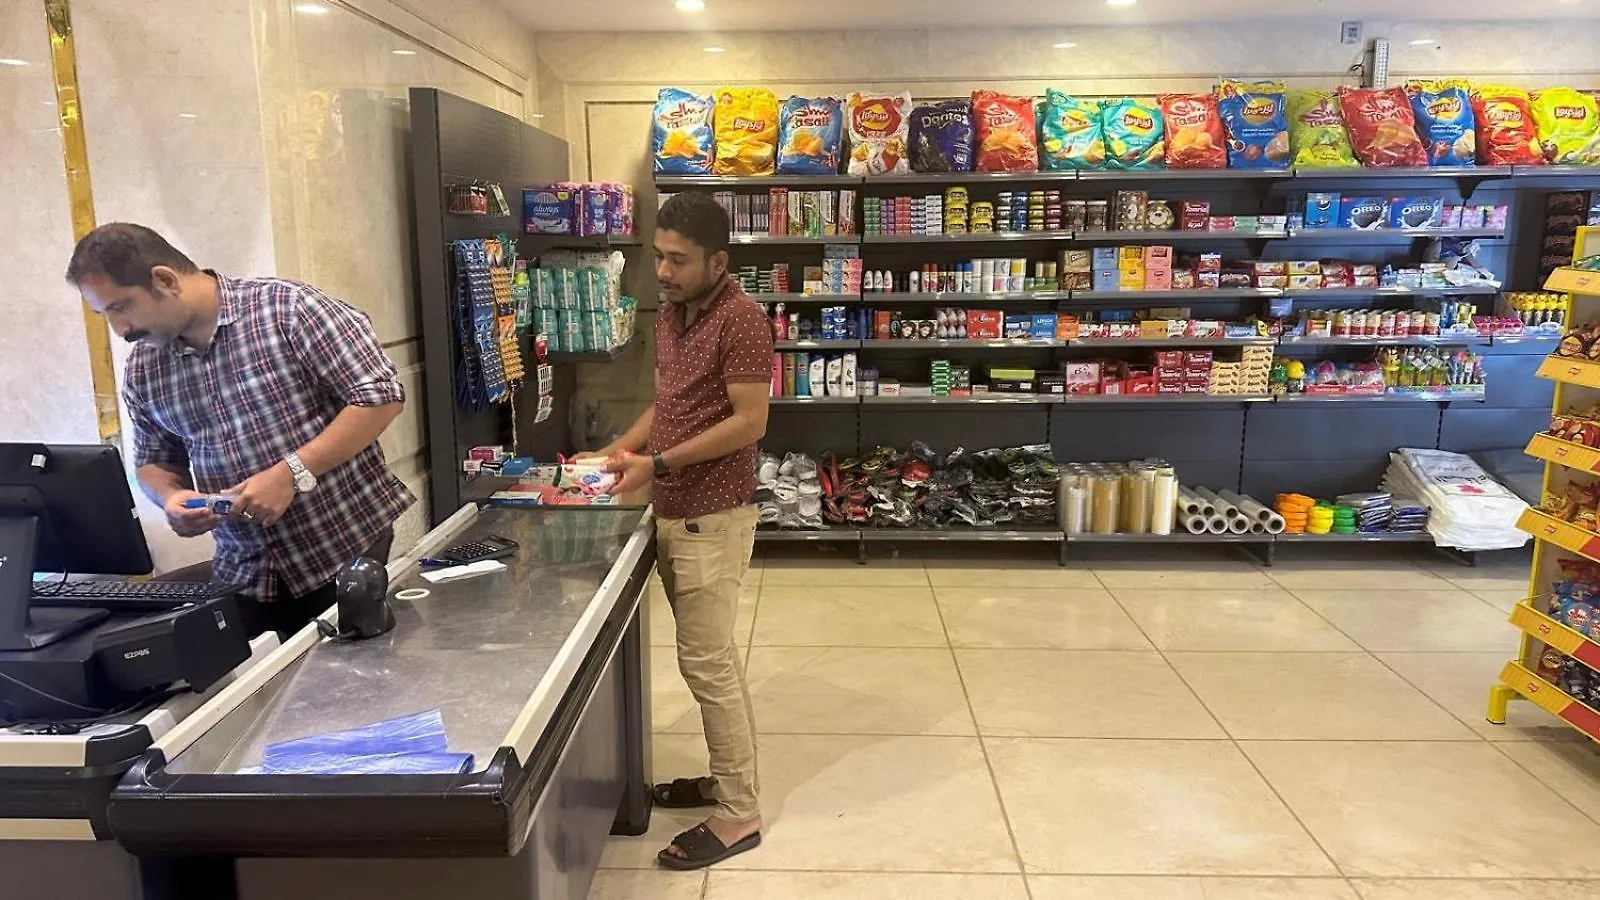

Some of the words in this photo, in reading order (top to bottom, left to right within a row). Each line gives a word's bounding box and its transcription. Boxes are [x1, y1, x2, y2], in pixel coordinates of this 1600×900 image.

[922, 110, 970, 128] Doritos
[1351, 205, 1381, 215] OREO
[1402, 204, 1432, 215] OREO
